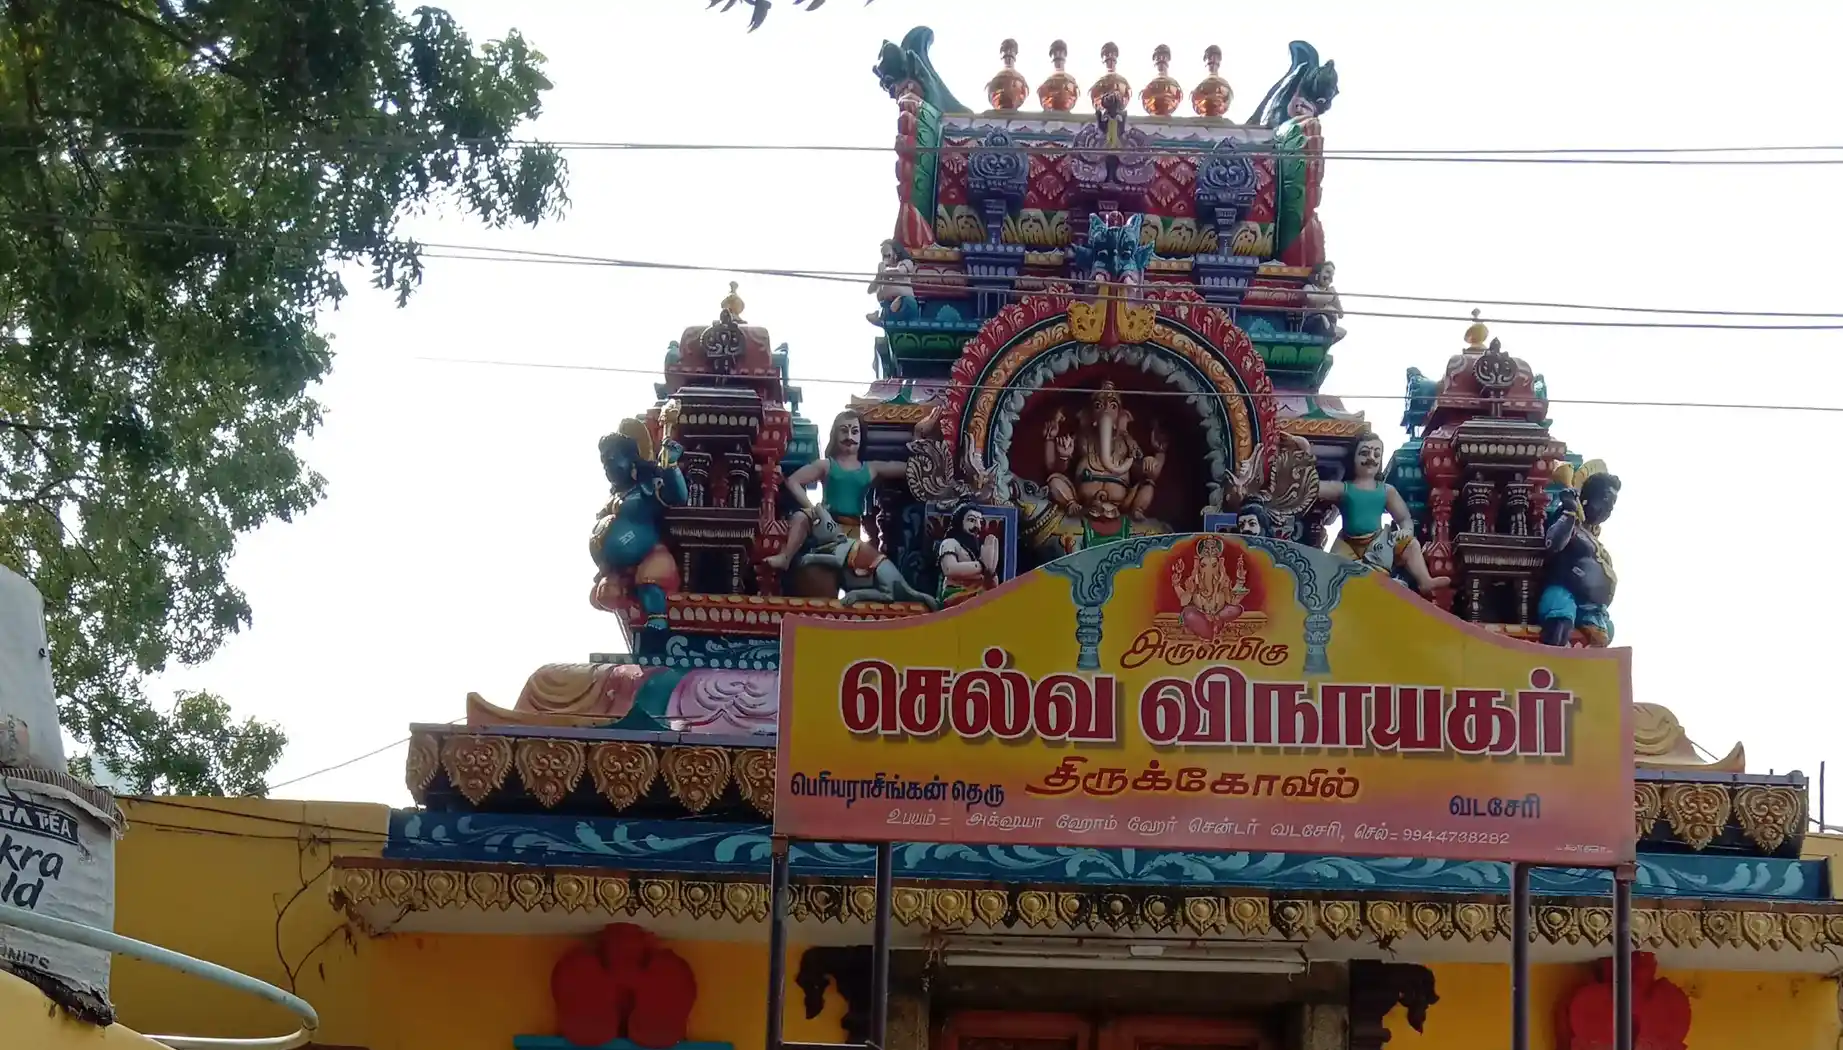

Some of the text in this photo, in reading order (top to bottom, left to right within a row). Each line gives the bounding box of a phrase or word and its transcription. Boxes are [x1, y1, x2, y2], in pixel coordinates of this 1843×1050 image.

[1120, 628, 1289, 669] அருள்மிகு
[839, 646, 1574, 757] செல்வ விநாயகர்
[1025, 755, 1361, 800] திருக்கோவில்
[952, 780, 1005, 812] தெரு
[1449, 794, 1541, 819] வடசேரி
[35, 809, 73, 839] TEA
[1188, 817, 1260, 836] சென்டர்
